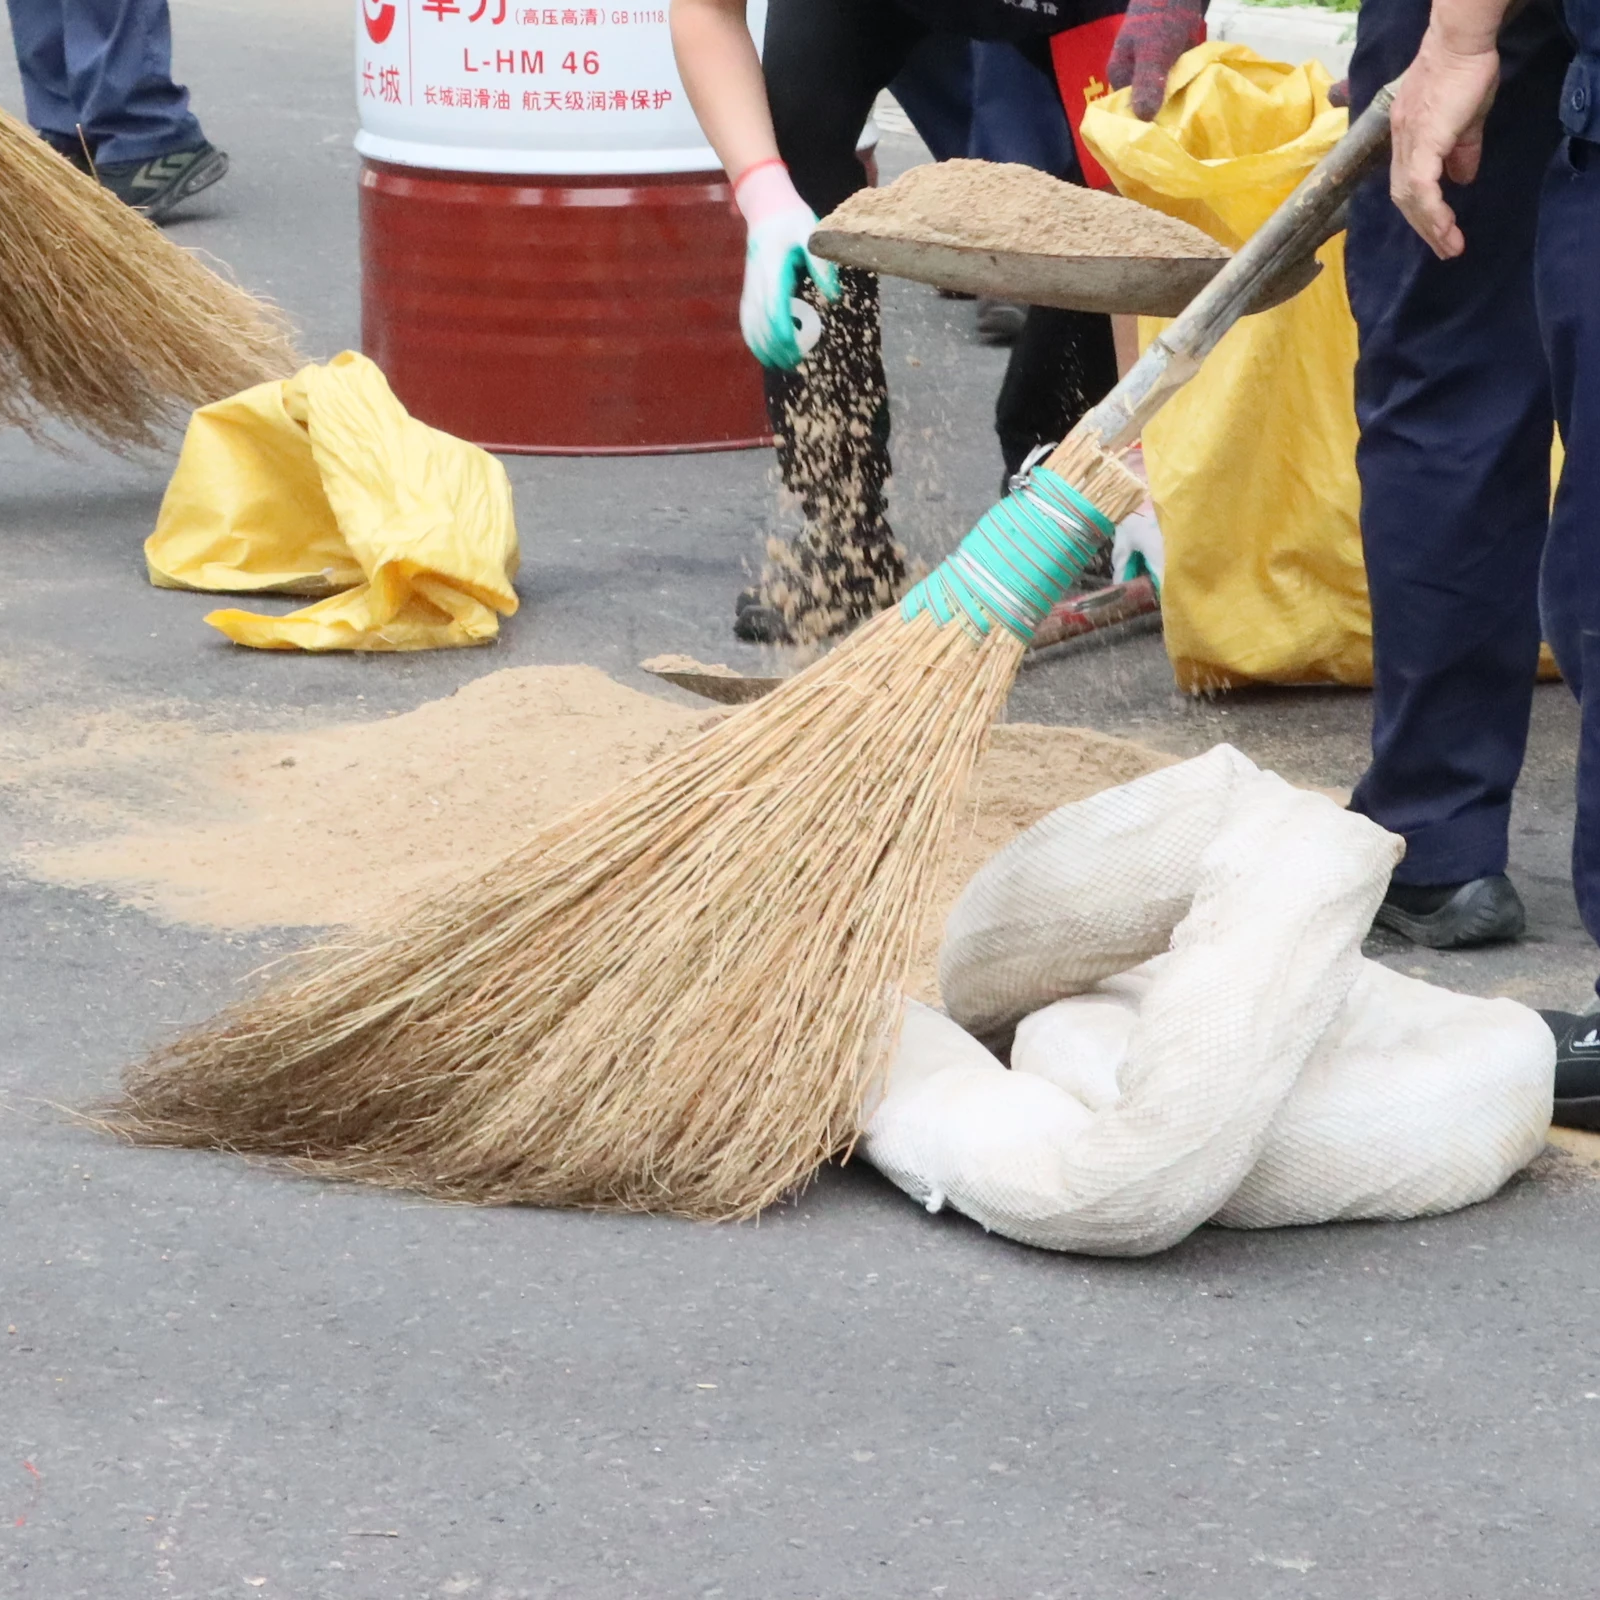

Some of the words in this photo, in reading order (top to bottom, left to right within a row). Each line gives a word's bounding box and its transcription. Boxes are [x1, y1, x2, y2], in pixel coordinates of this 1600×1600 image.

[611, 10, 629, 24] GB
[463, 47, 544, 74] L-HM
[561, 50, 600, 75] 46
[361, 57, 402, 105] 长城
[423, 84, 511, 111] 长城润滑油
[522, 88, 673, 111] 航天级润滑保护
